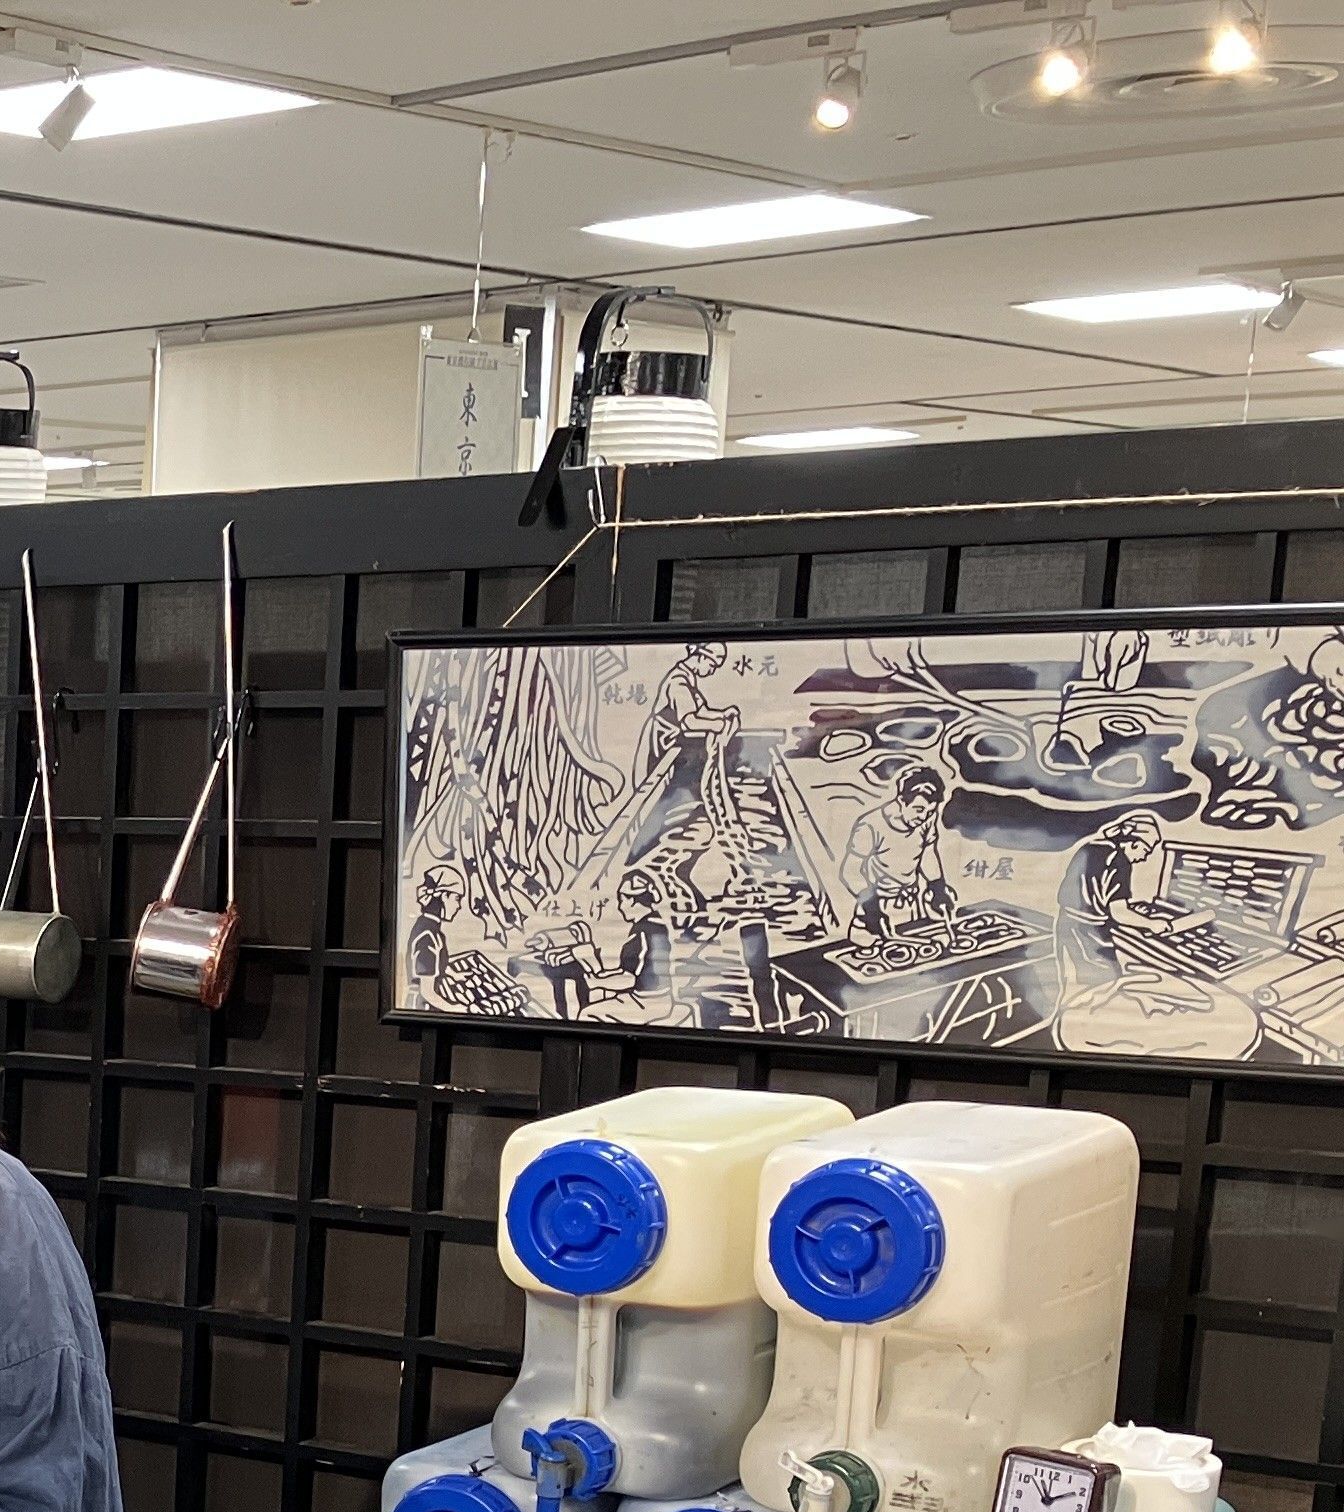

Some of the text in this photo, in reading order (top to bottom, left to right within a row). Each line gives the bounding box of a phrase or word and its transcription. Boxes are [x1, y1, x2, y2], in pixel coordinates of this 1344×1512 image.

[456, 381, 477, 476] 東京
[732, 654, 779, 677] 水元
[542, 898, 610, 921] 仕上げ
[1034, 1468, 1044, 1478] 11
[1048, 1471, 1060, 1481] 12
[1018, 1473, 1031, 1484] 10
[1015, 1490, 1023, 1499] 9
[1079, 1488, 1086, 1497] 2
[1075, 1504, 1083, 1512] 3
